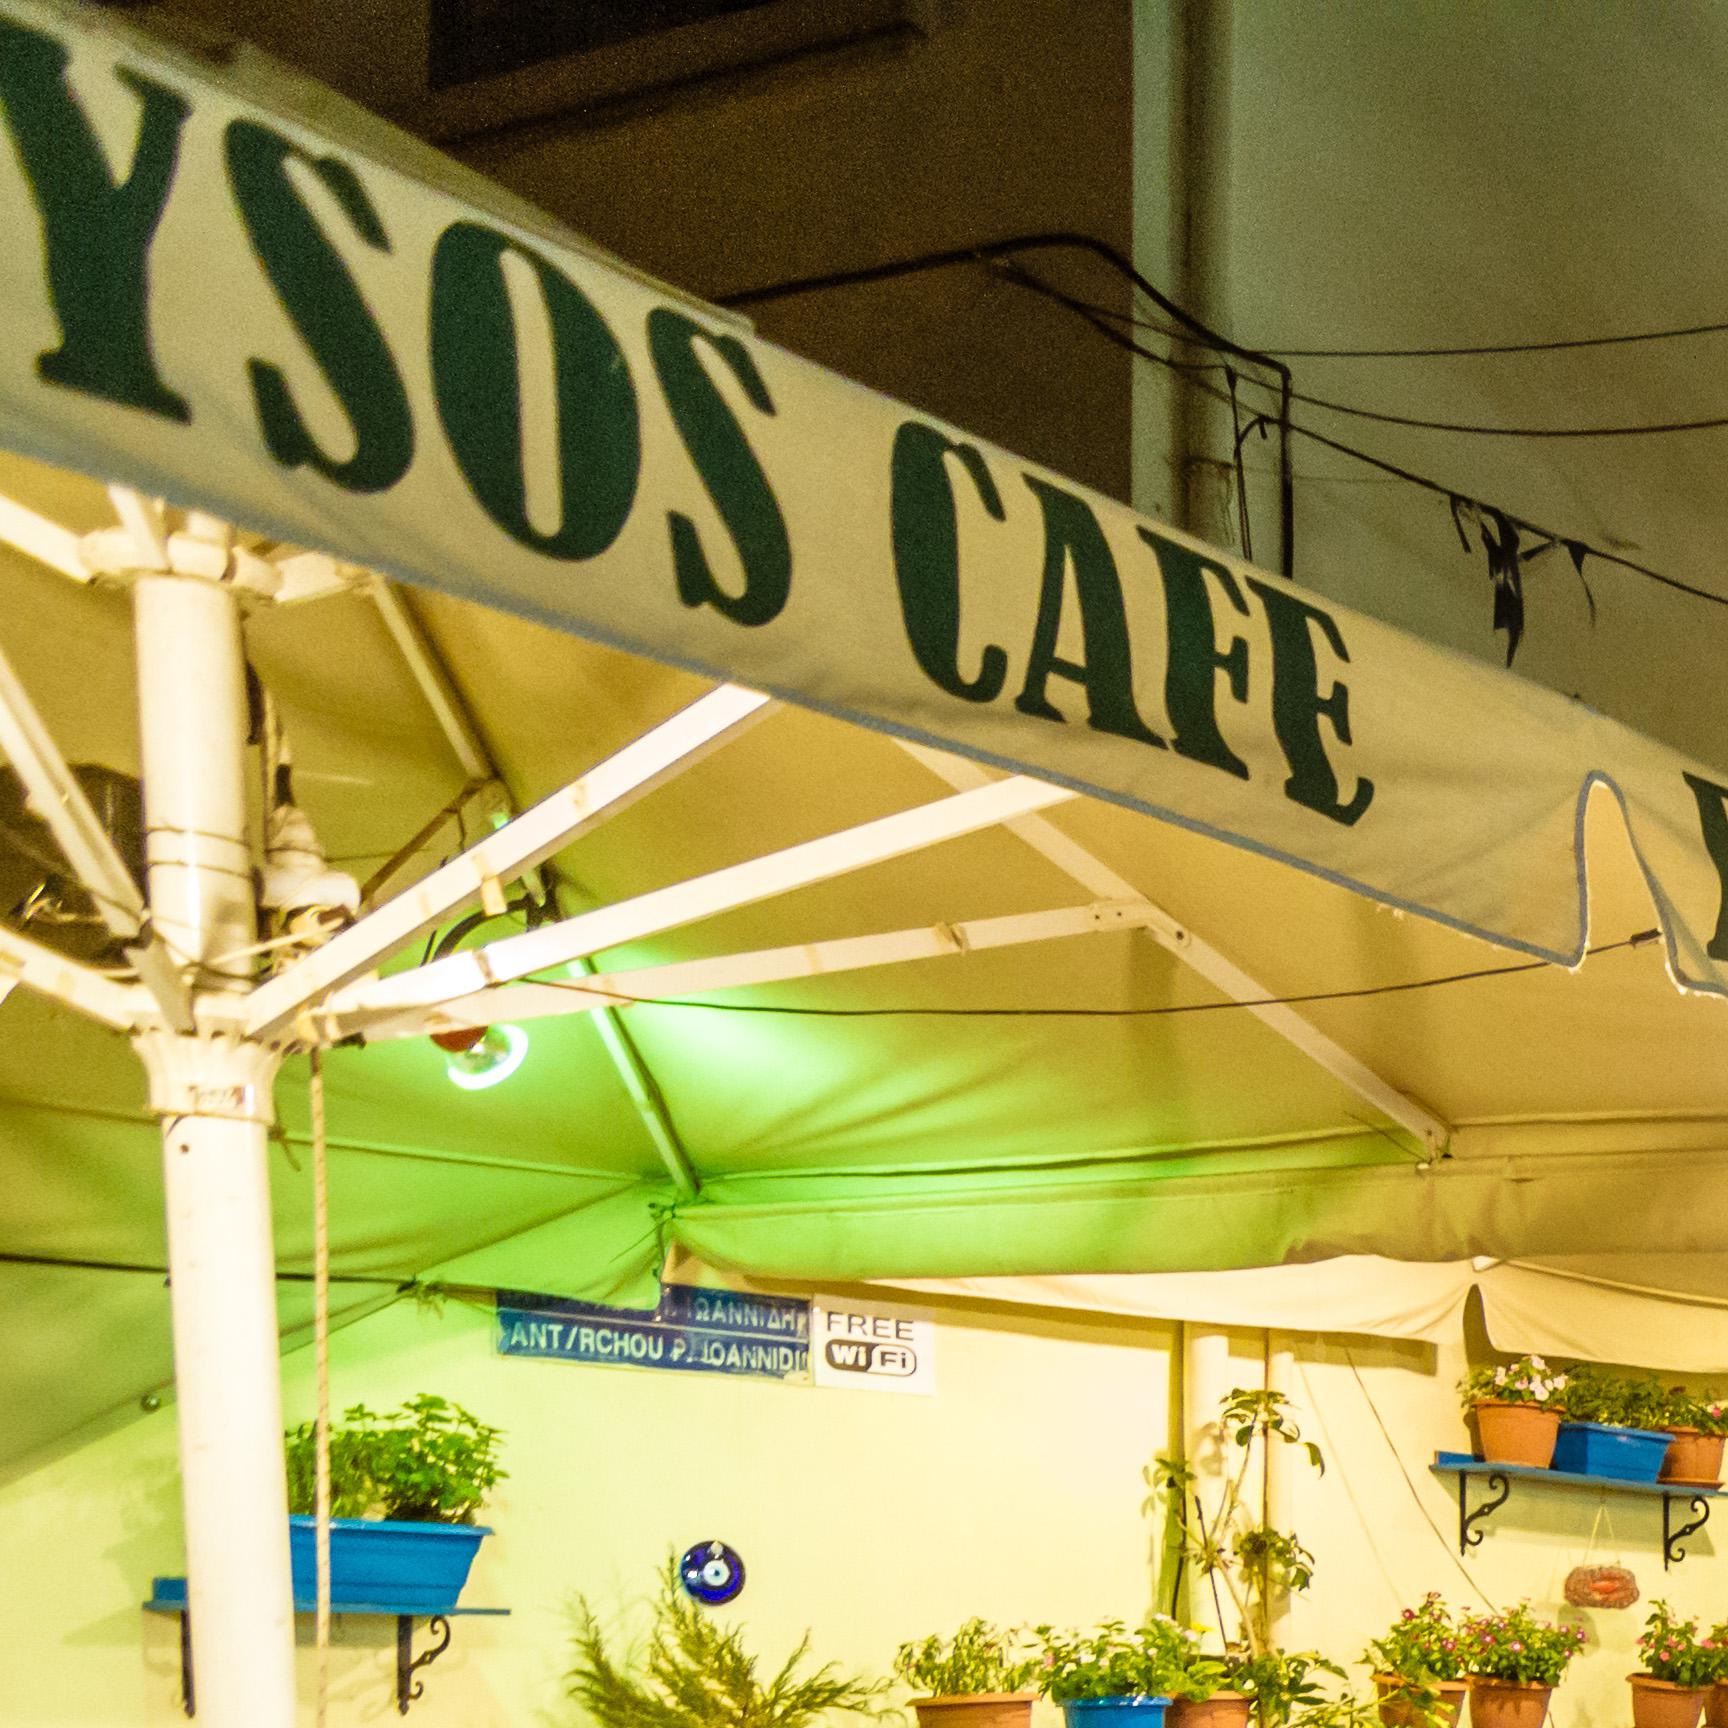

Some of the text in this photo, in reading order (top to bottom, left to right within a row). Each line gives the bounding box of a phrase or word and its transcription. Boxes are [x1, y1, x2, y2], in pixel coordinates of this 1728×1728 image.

[889, 420, 1375, 828] CAFE
[510, 1321, 664, 1361] ANT/RCHOU
[826, 1310, 915, 1342] FREE
